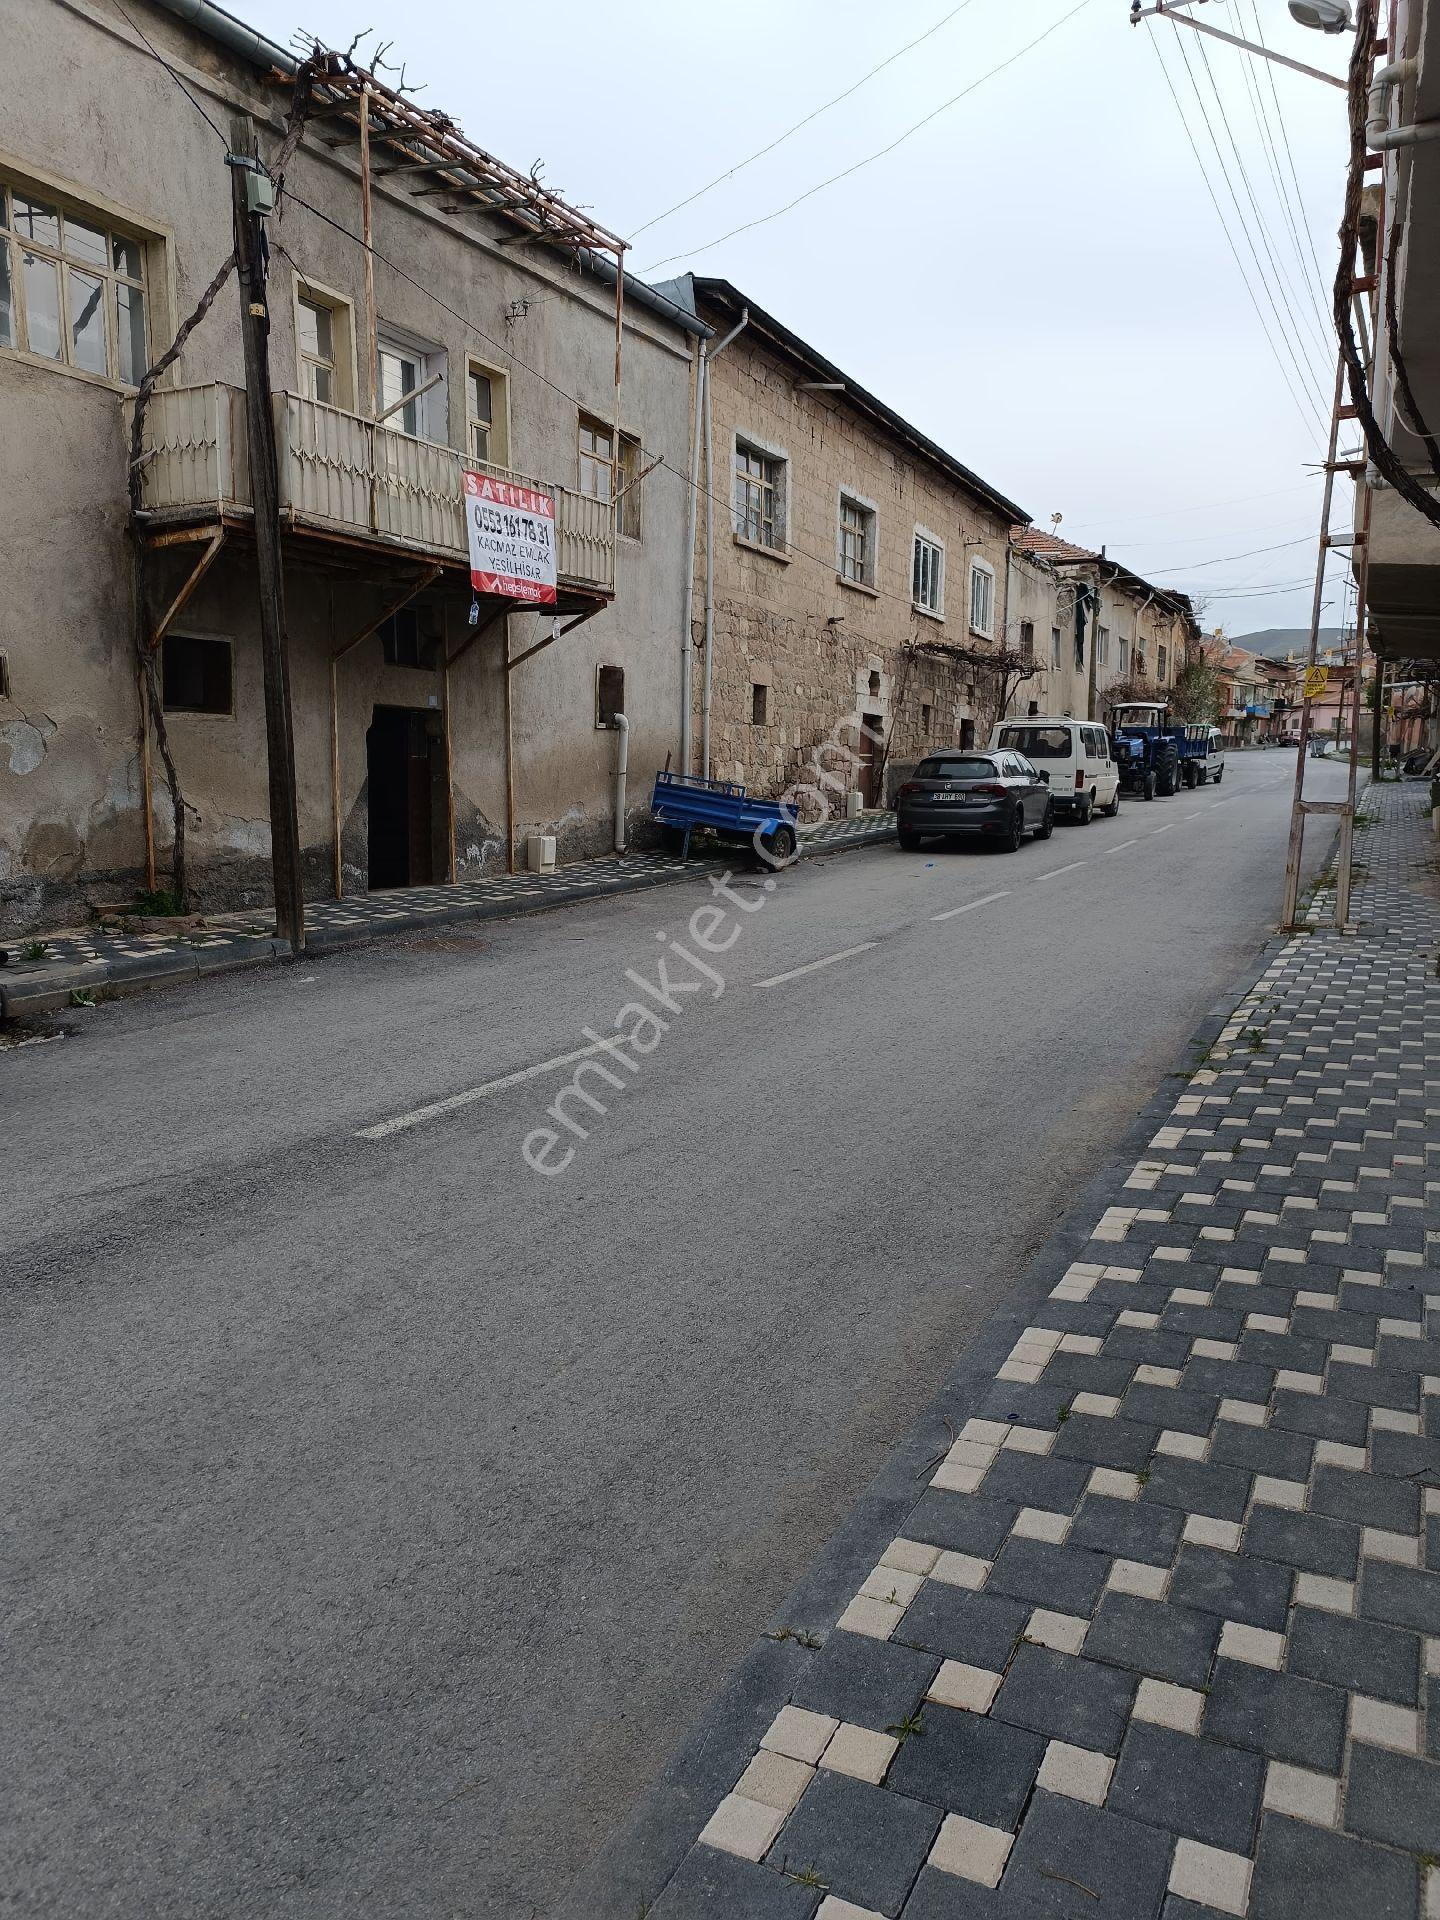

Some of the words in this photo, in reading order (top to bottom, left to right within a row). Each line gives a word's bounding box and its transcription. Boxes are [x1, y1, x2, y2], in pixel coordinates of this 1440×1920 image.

[466, 474, 550, 516] SATILIK
[474, 504, 502, 535] 0553
[522, 519, 537, 543] 78
[520, 545, 550, 565] EMLAK
